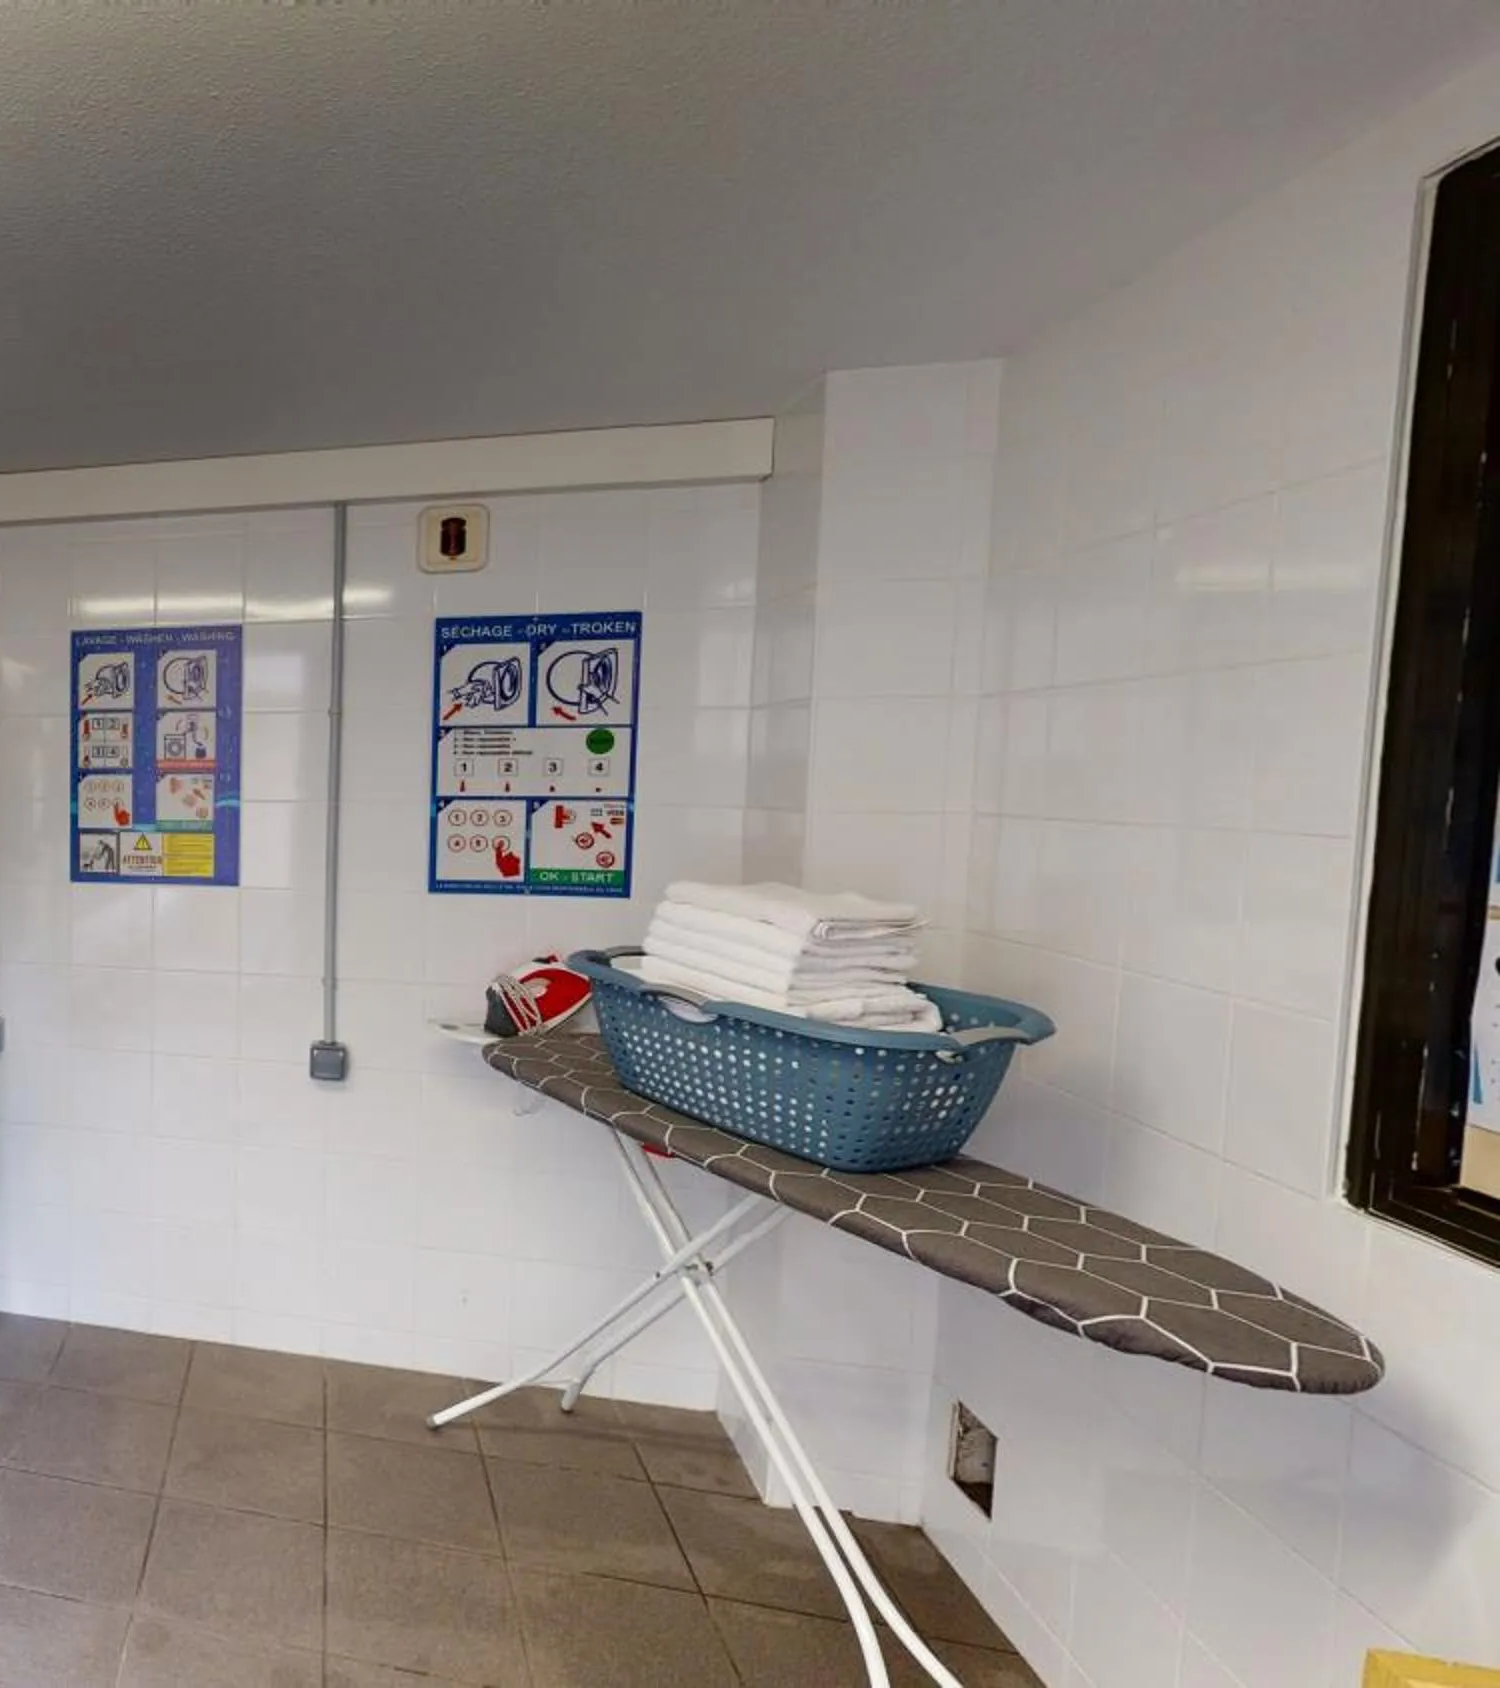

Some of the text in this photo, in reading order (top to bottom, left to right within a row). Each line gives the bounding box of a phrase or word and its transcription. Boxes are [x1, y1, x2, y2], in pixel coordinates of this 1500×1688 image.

[526, 623, 557, 637] DRY
[572, 621, 636, 635] TROKEN
[460, 762, 467, 773] 1
[503, 762, 513, 773] 2
[549, 762, 557, 773] 3
[594, 762, 603, 773] 4
[540, 871, 559, 881] OK
